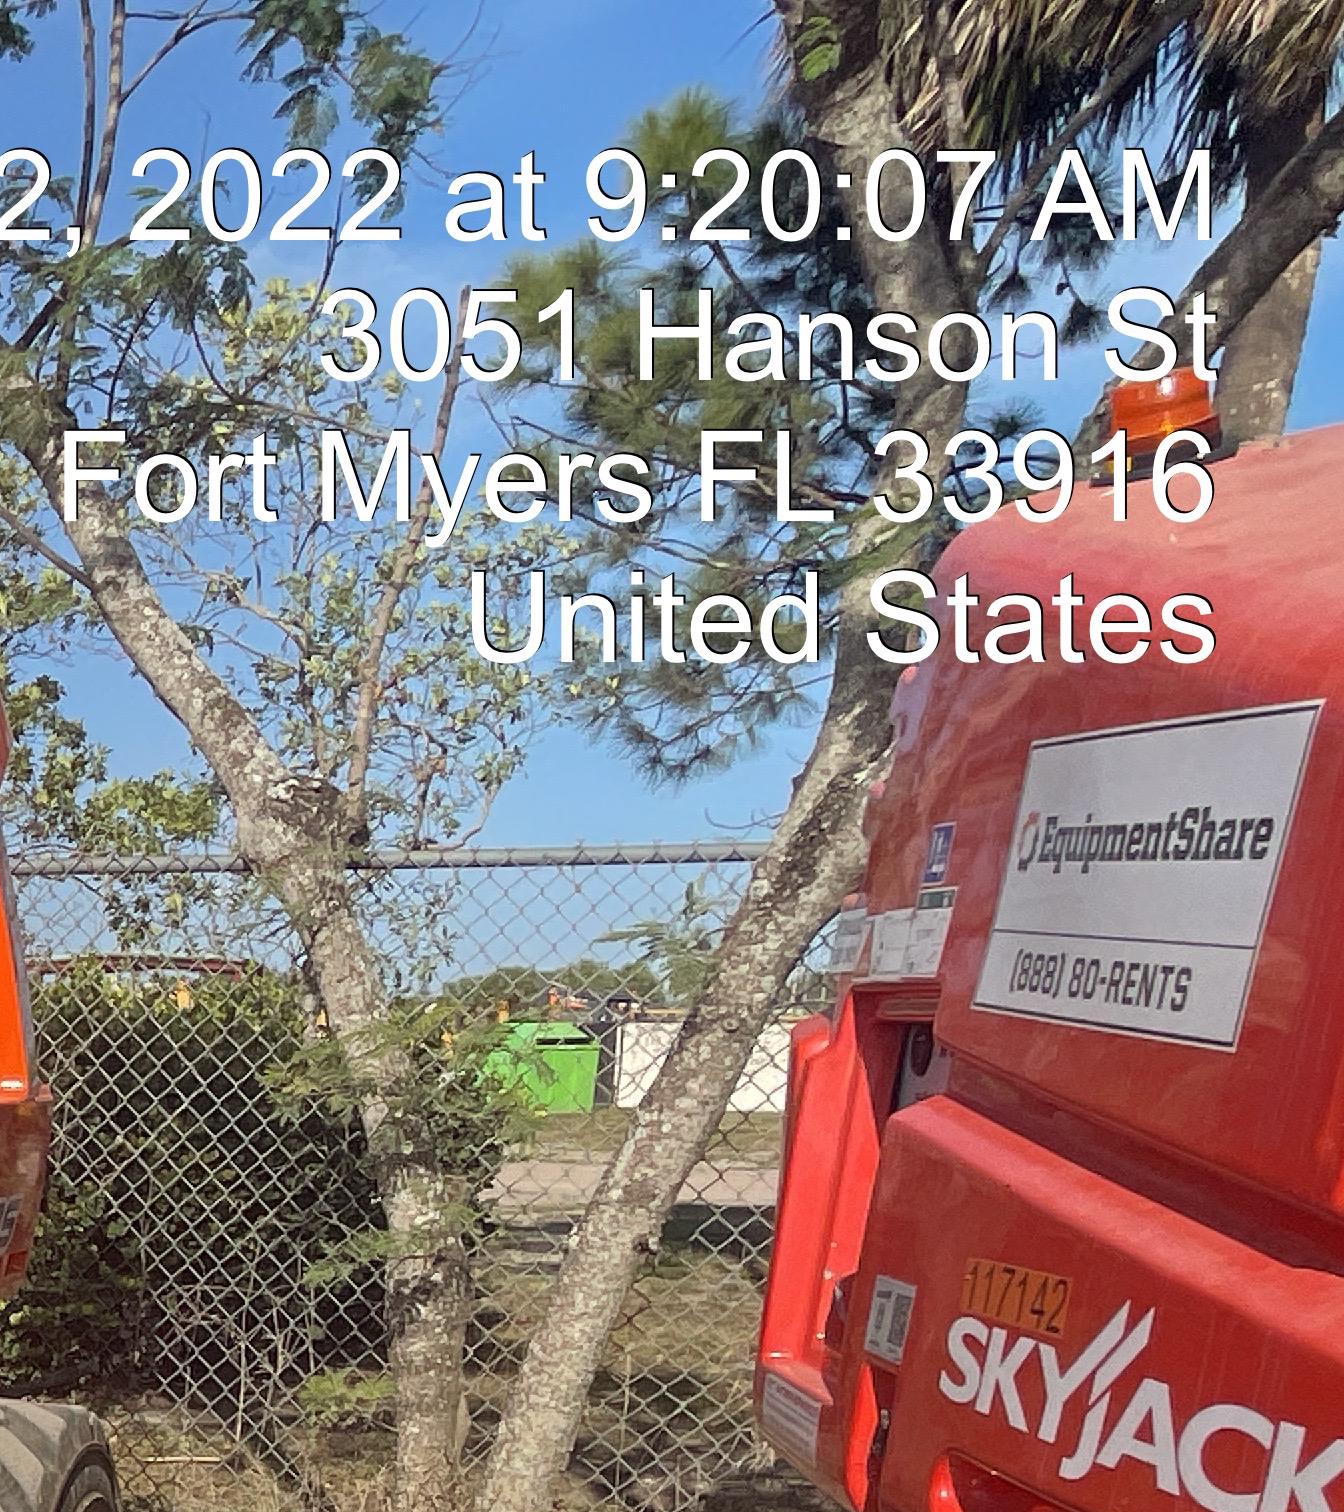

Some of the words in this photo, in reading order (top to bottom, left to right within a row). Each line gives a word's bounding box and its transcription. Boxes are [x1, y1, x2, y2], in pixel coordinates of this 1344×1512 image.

[1037, 806, 1274, 873] EquipmentShare
[1008, 948, 1066, 999] (888)
[1068, 957, 1192, 1012] 80-RENTS
[967, 1262, 1067, 1334] 117142
